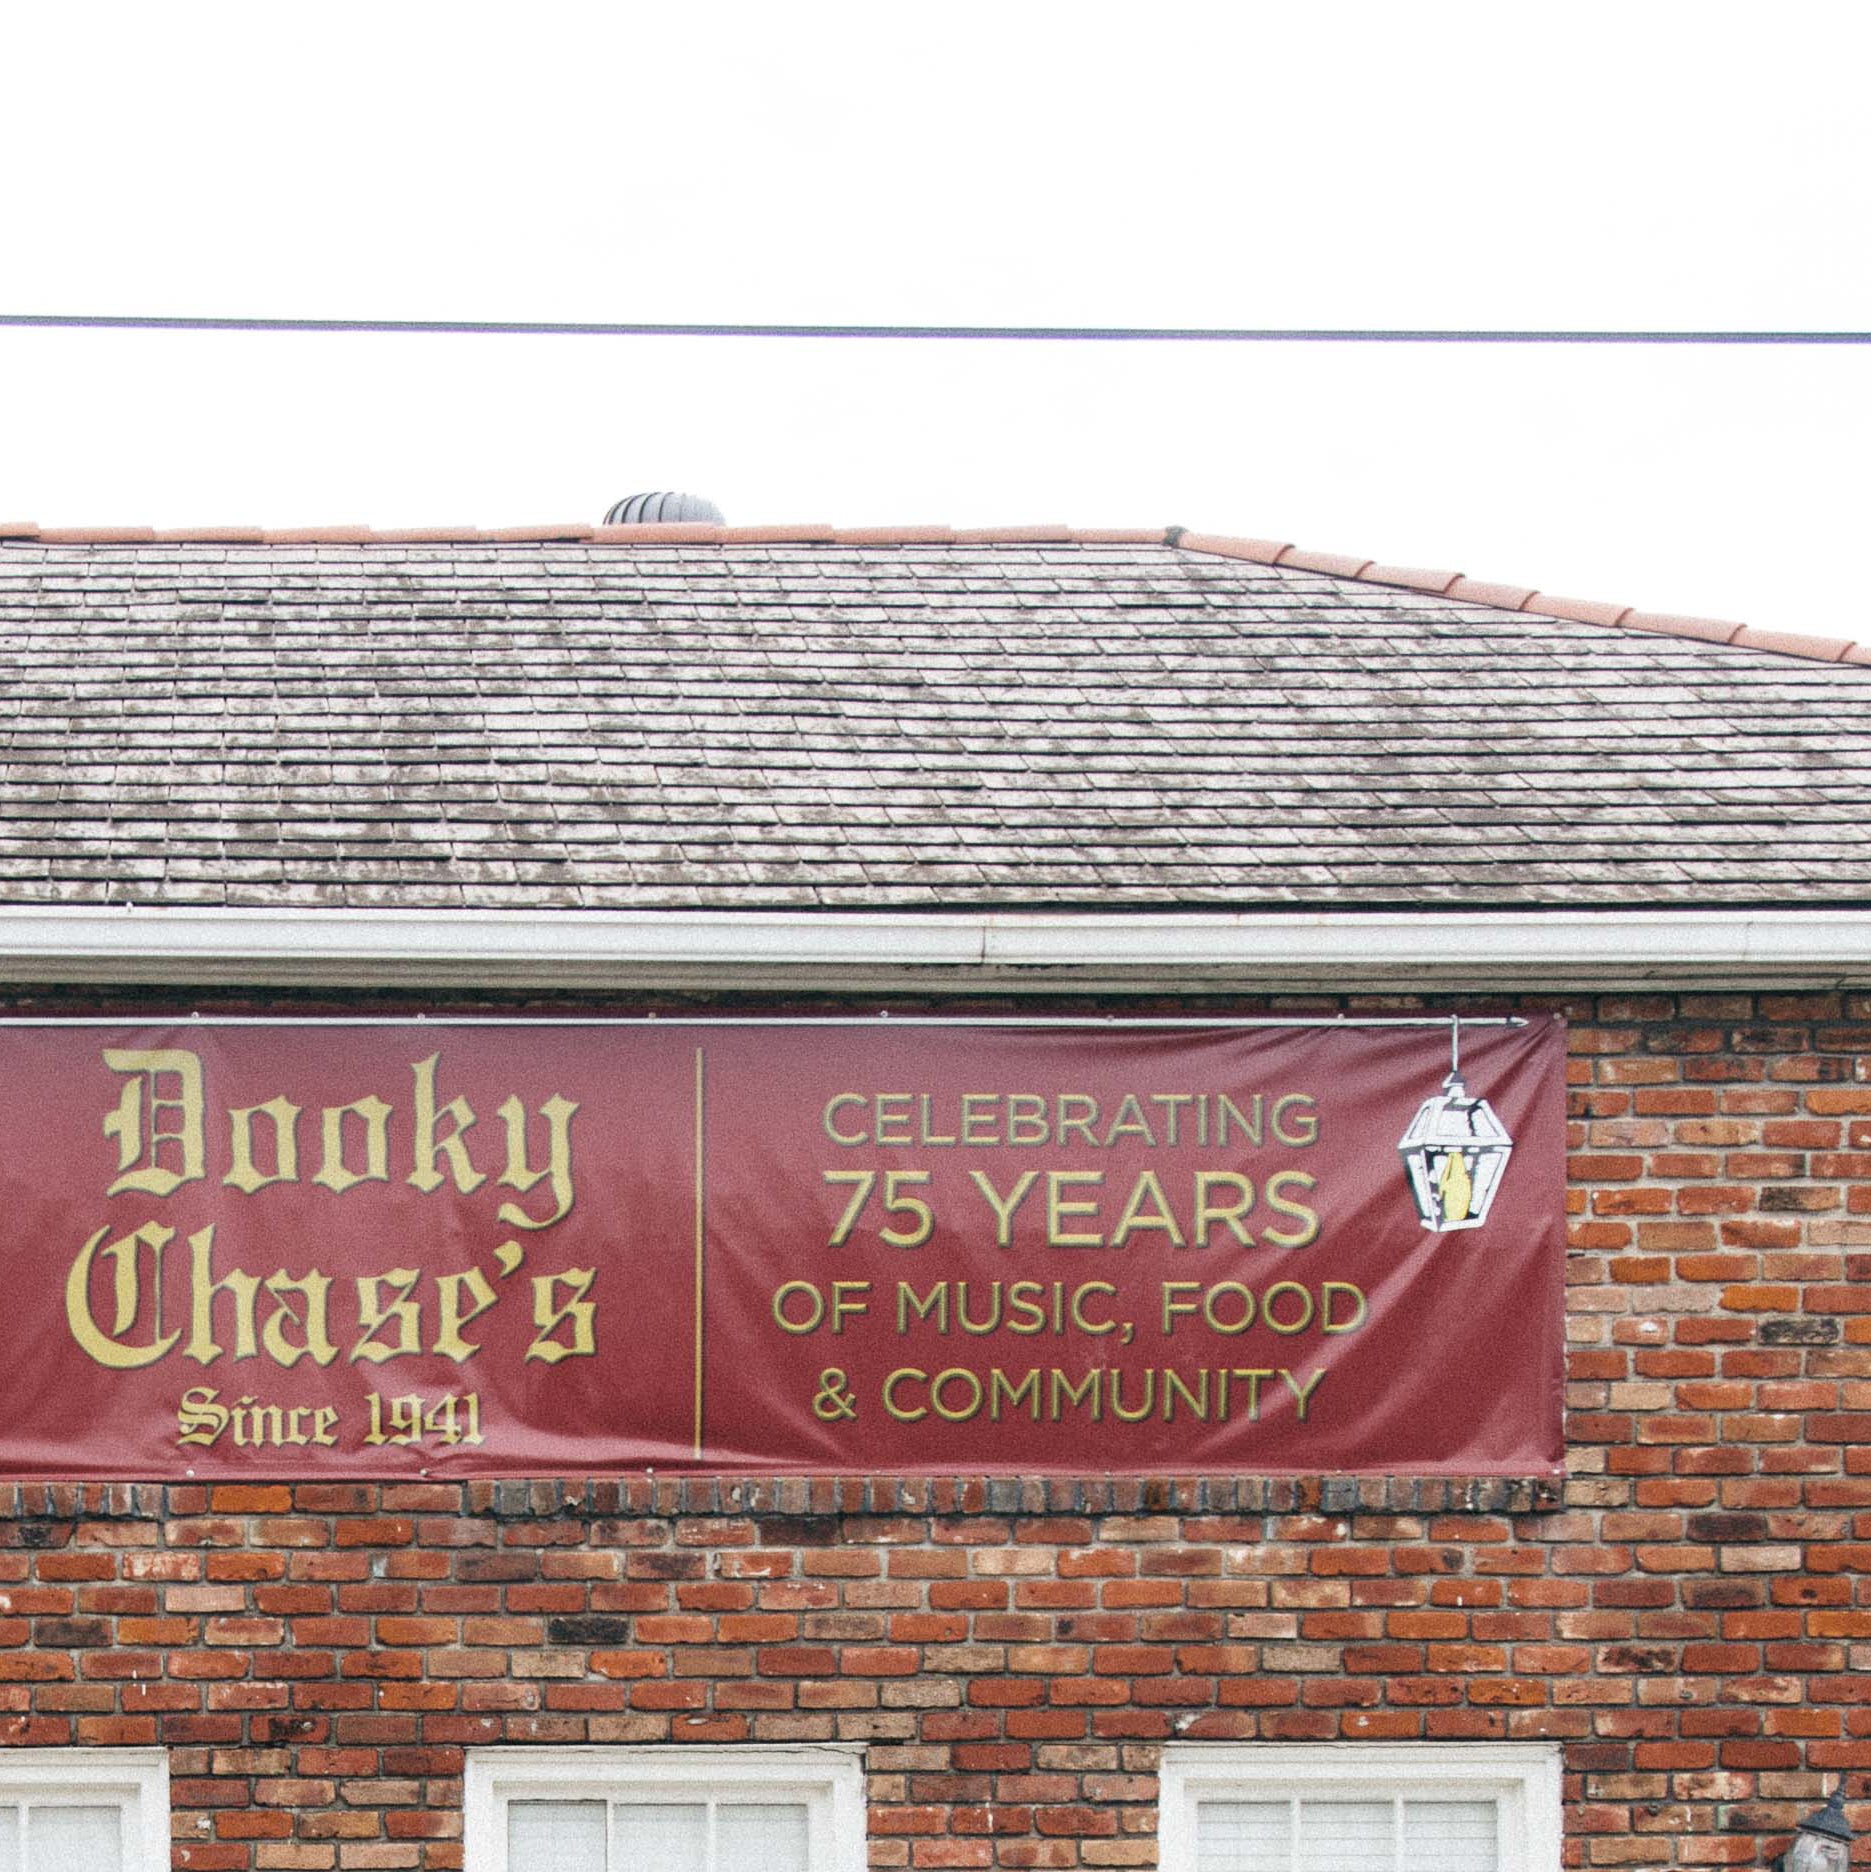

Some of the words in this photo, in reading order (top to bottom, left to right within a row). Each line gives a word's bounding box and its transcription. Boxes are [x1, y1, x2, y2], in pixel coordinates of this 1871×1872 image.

[92, 1047, 580, 1230] Dooky
[822, 1092, 1319, 1147] CELEBRATING
[822, 1168, 935, 1249] 75
[969, 1168, 1321, 1249] YEARS
[64, 1220, 599, 1370] Chase's
[770, 1279, 872, 1336] OF
[894, 1279, 1135, 1345] MUSIC,
[1160, 1279, 1369, 1336] FOOD
[175, 1385, 340, 1448] Since
[362, 1391, 485, 1447] 1941
[811, 1365, 859, 1423] &
[880, 1365, 1326, 1424] COMMUNITY
